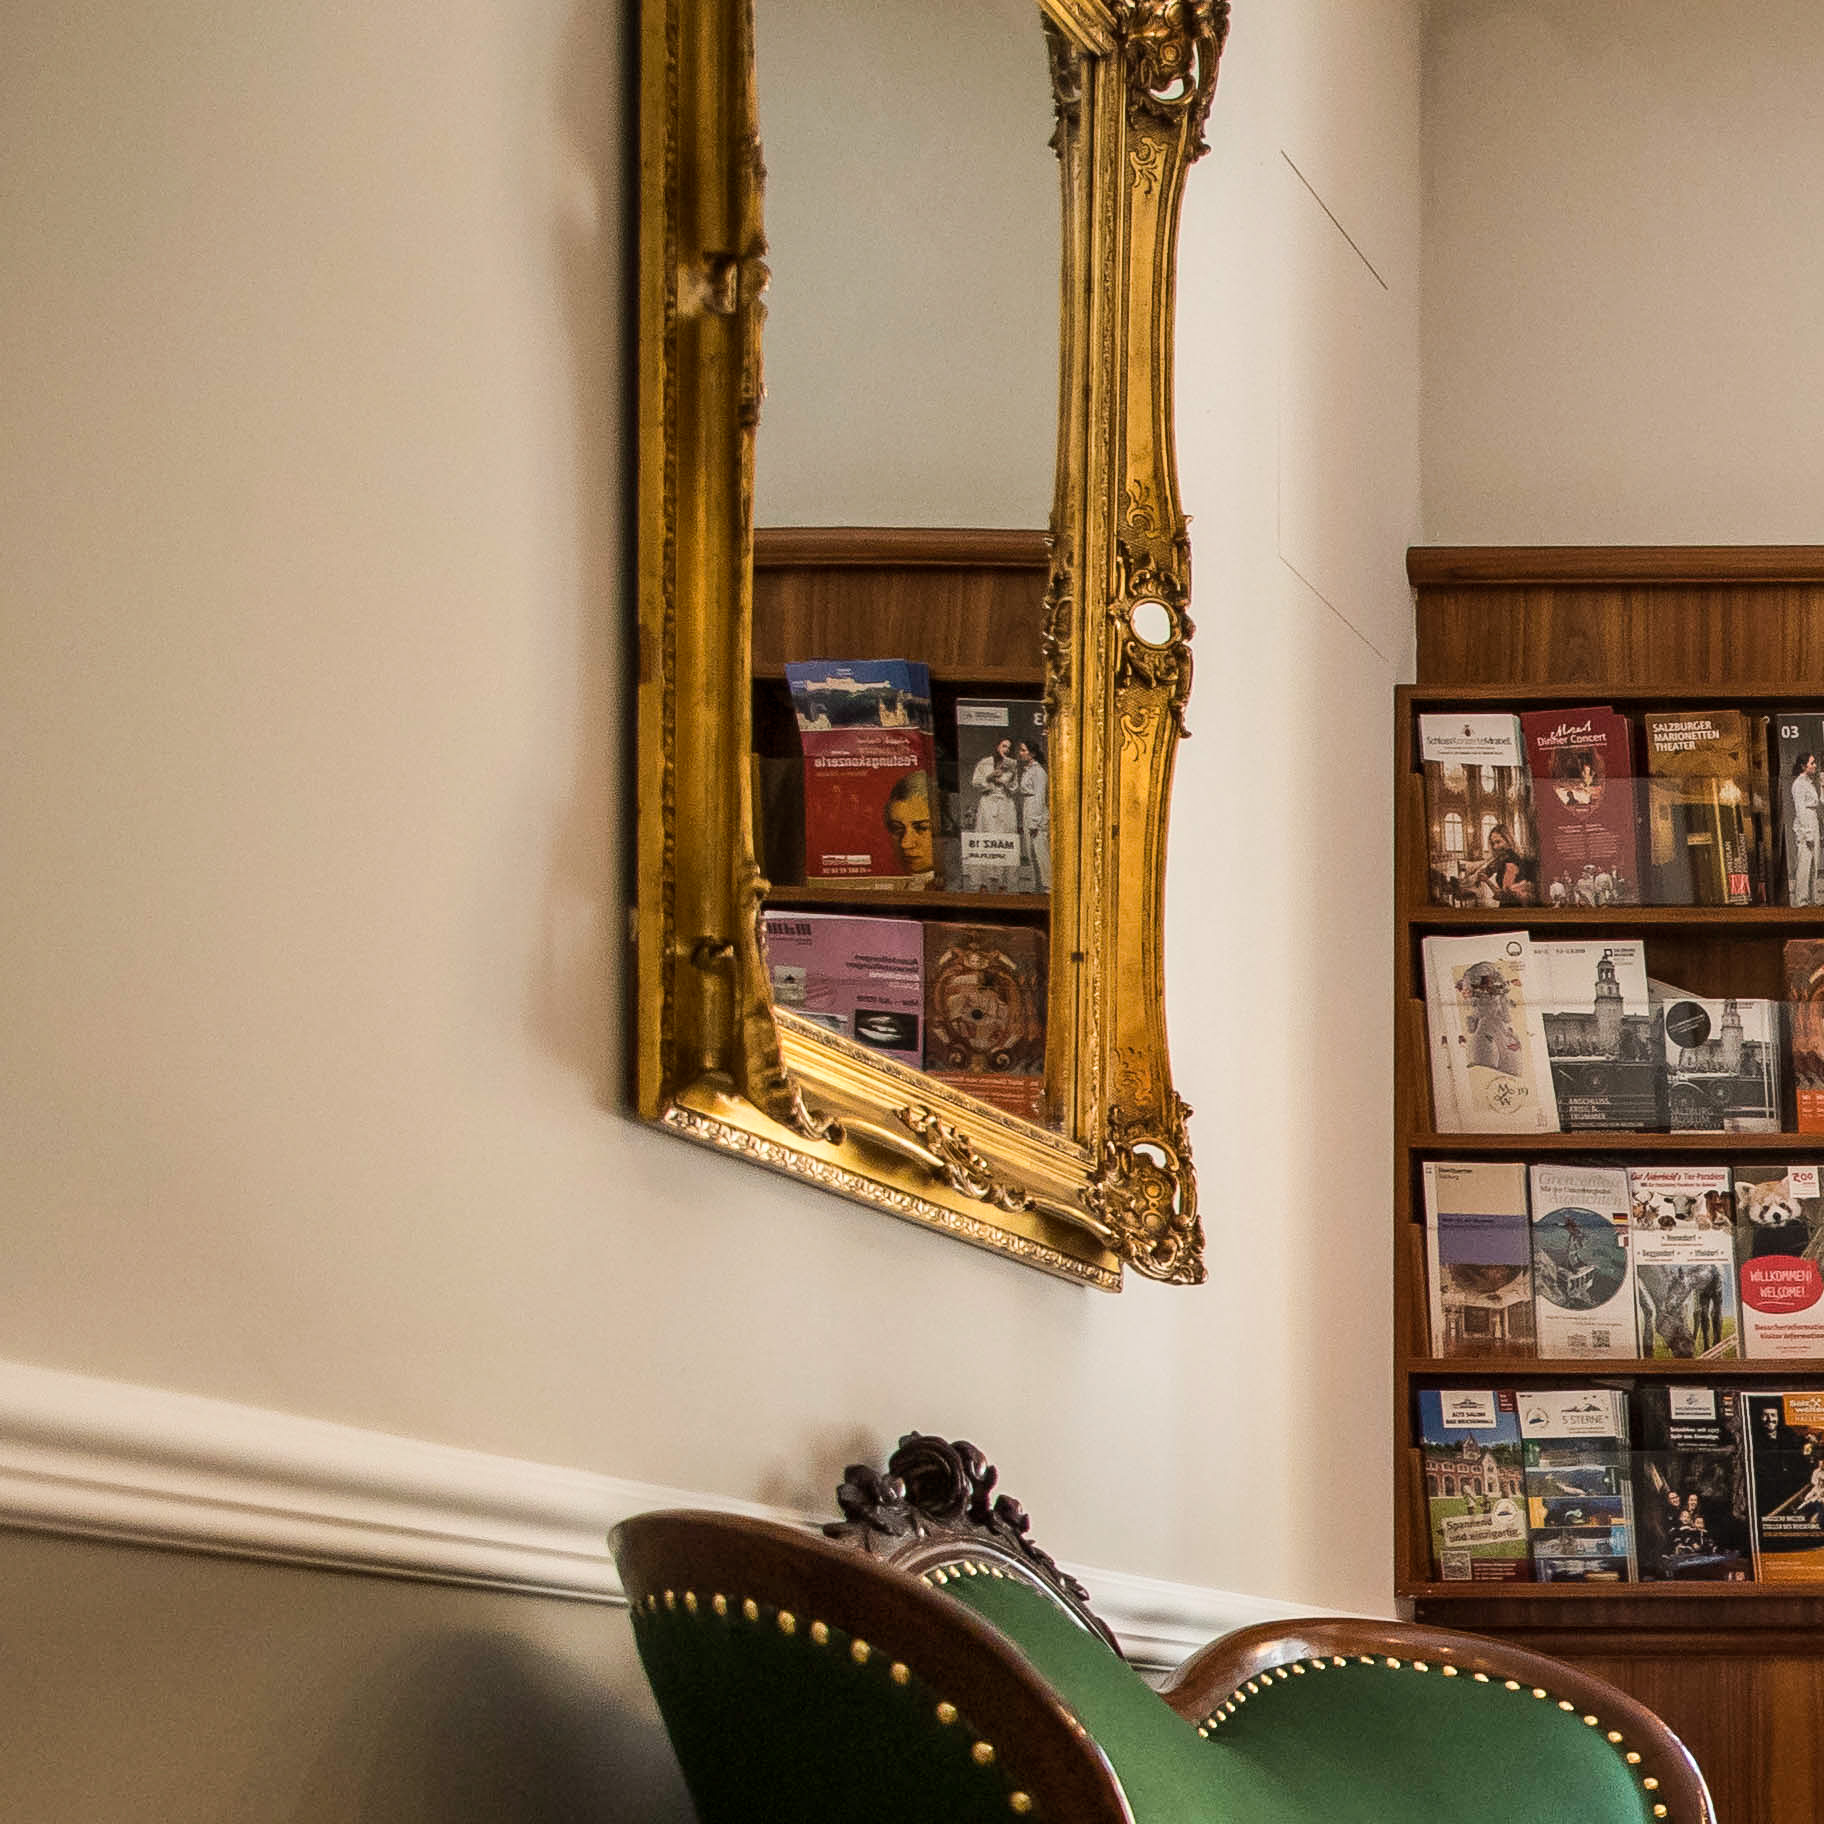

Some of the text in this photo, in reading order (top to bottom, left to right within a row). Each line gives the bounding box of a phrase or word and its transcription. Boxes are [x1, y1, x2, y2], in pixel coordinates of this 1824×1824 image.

[1652, 721, 1713, 733] SALZBURGER
[1780, 726, 1800, 739] 03
[1537, 733, 1608, 747] Dinner Concert
[1654, 730, 1721, 743] MARIONETTEN
[1655, 740, 1697, 753] THEATER
[1760, 1286, 1806, 1299] WELCOME!
